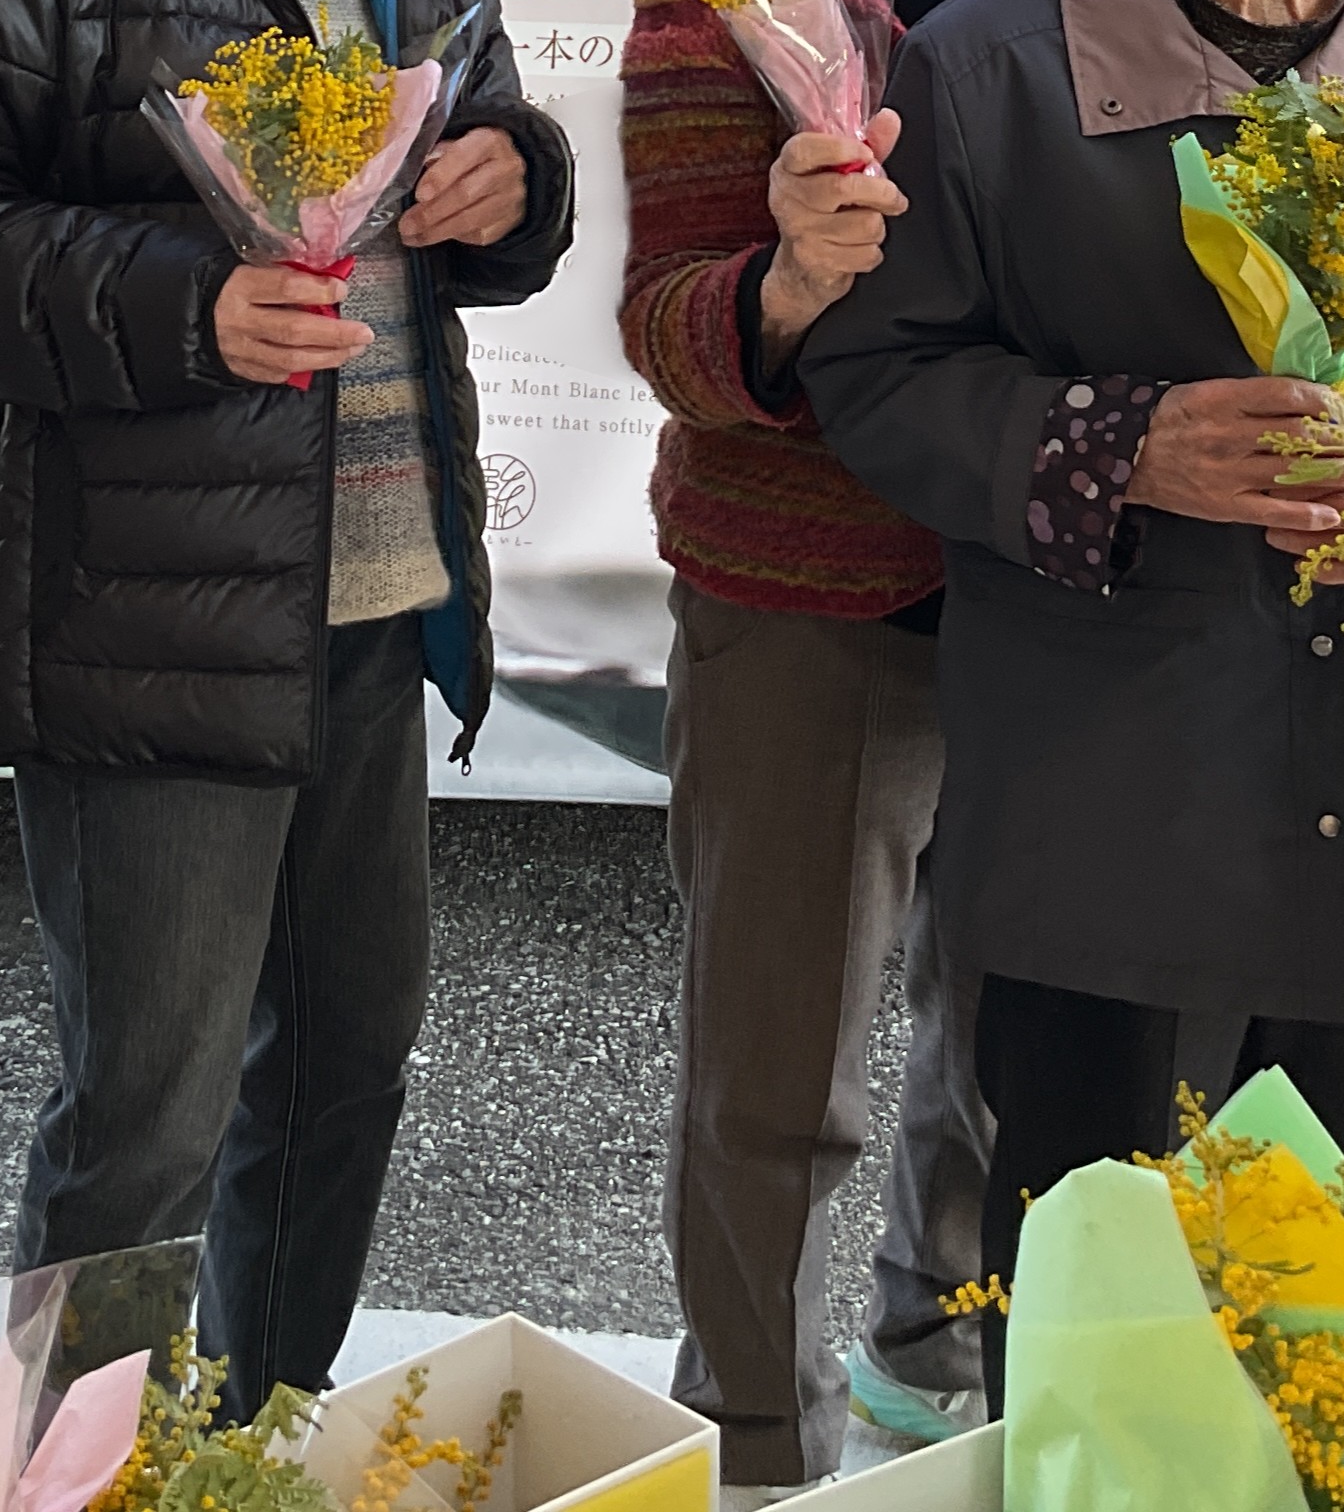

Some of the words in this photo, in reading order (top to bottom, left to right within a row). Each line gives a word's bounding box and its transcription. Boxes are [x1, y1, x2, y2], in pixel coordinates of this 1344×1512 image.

[479, 381, 501, 393] ur
[511, 379, 559, 397] Mont
[569, 382, 621, 401] Blanc
[486, 413, 543, 428] sweet
[552, 415, 589, 431] that
[599, 418, 655, 438] softly
